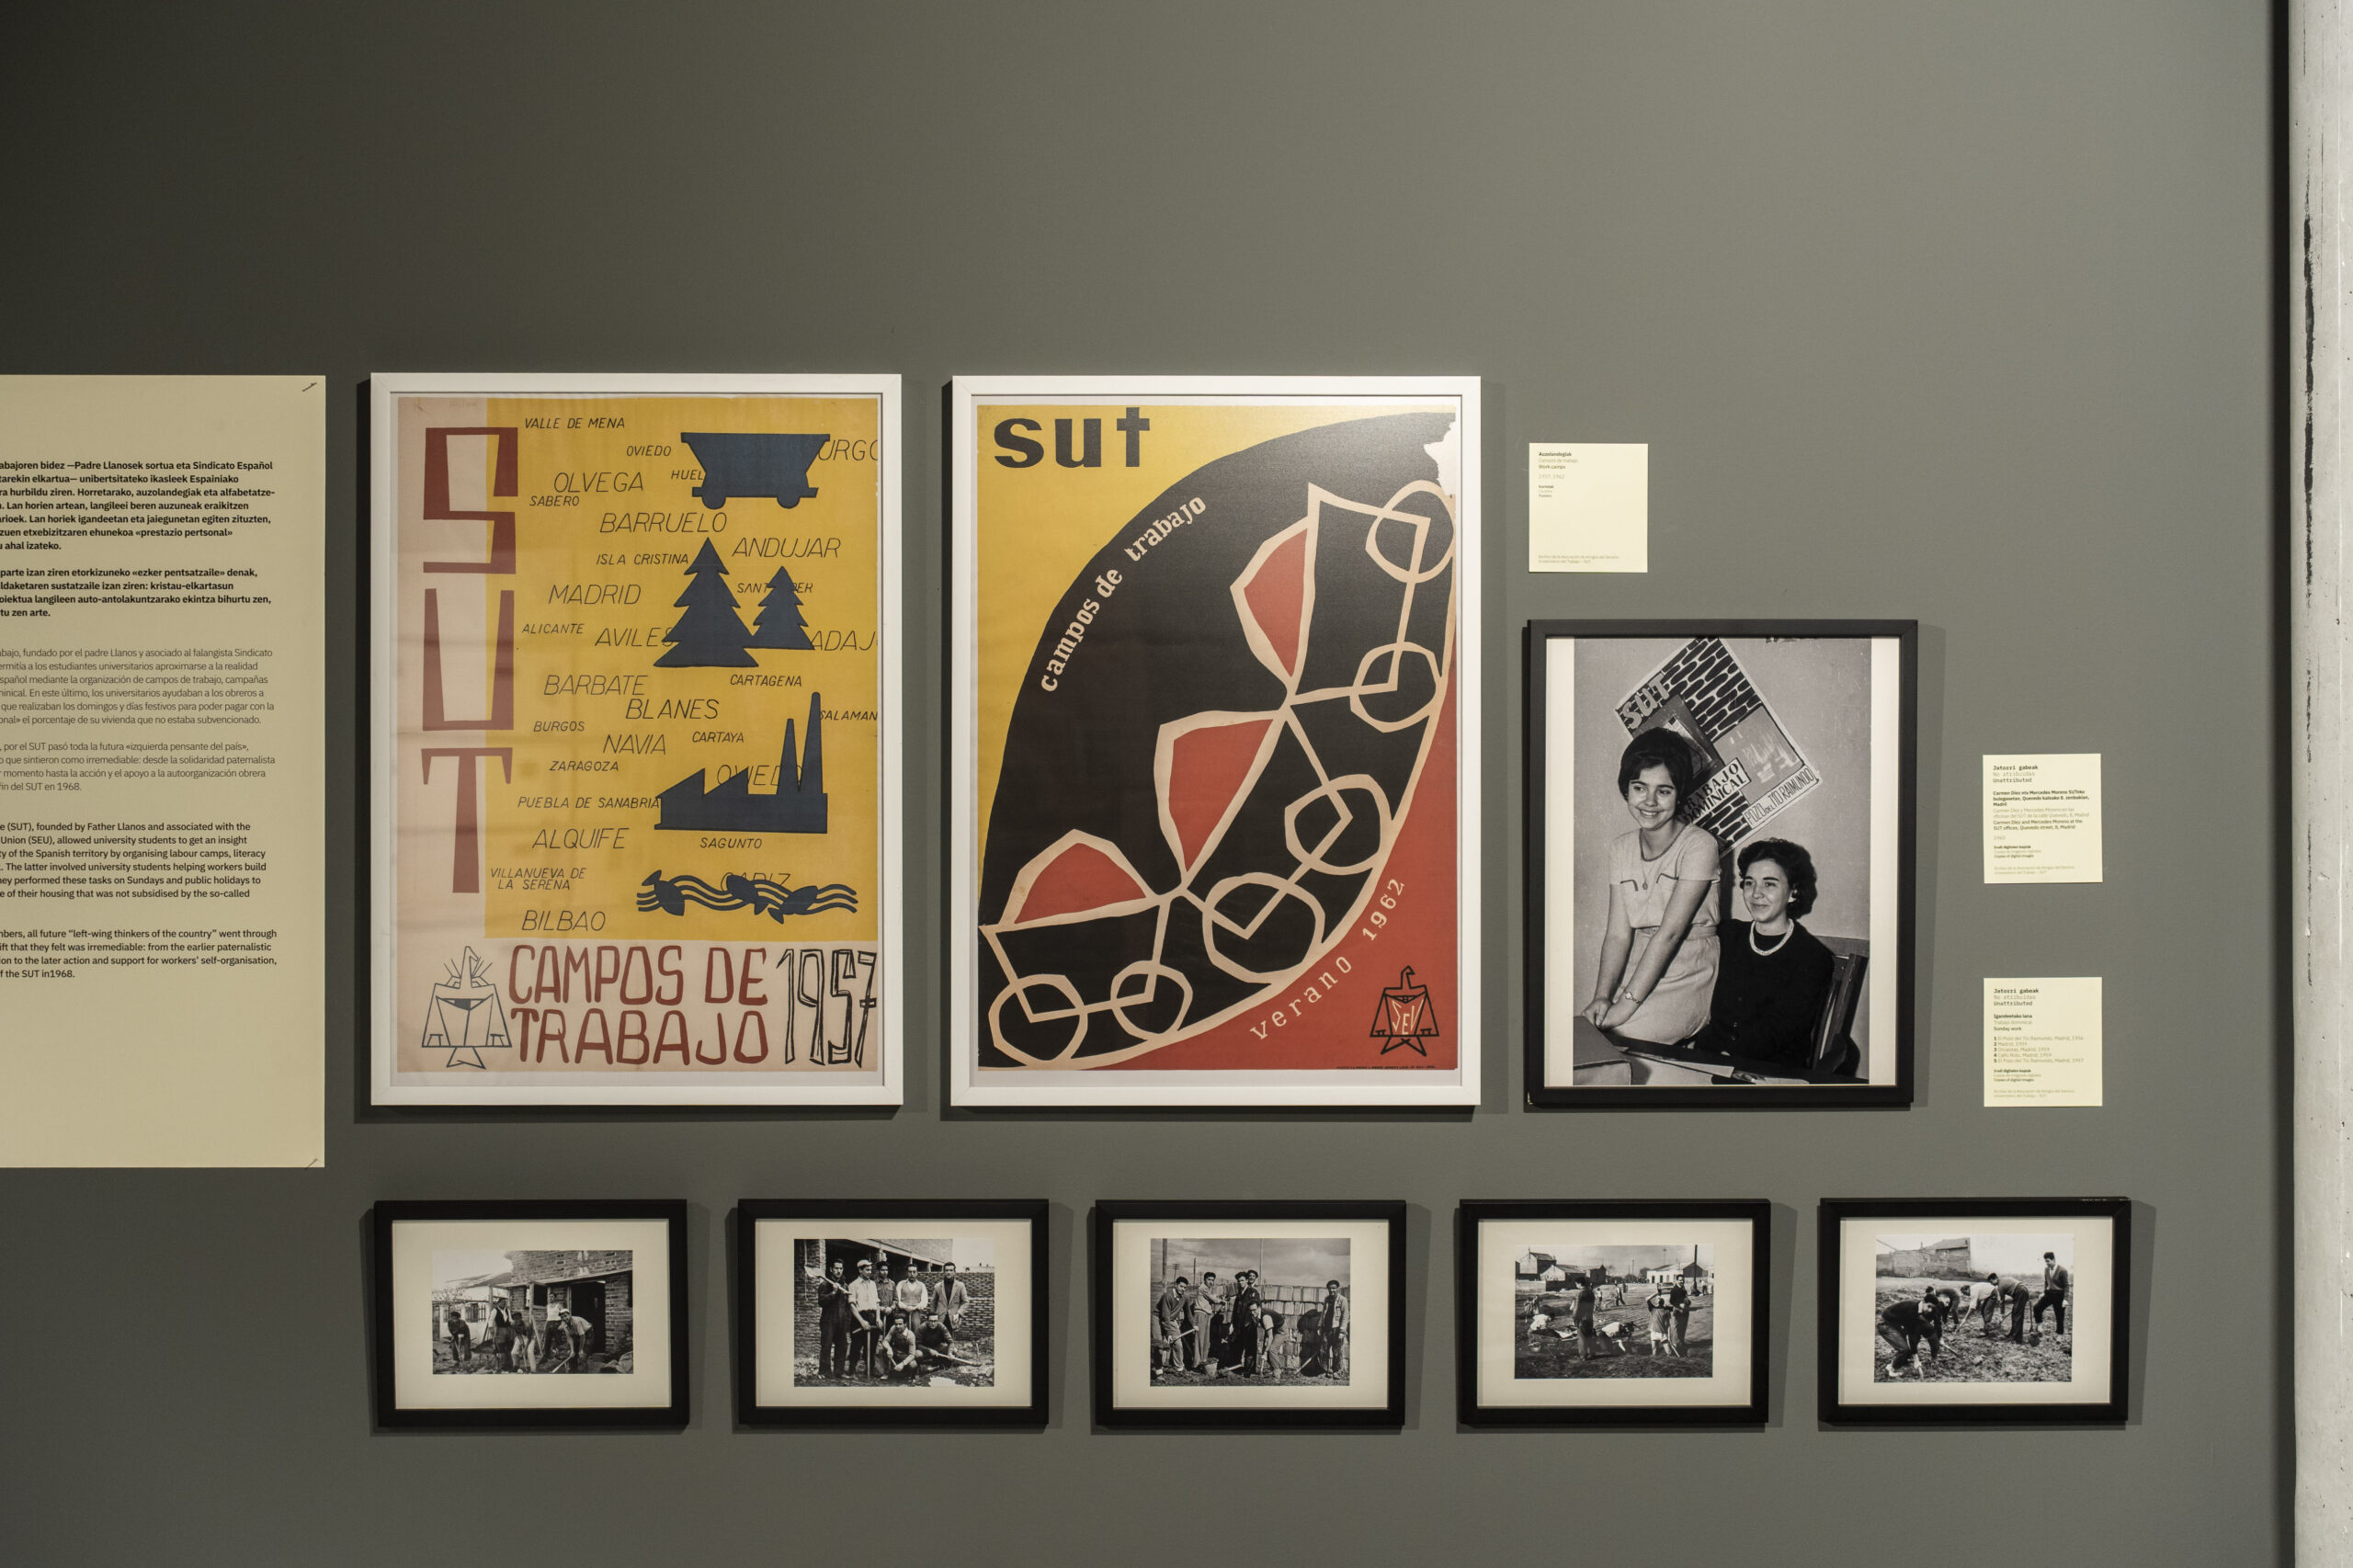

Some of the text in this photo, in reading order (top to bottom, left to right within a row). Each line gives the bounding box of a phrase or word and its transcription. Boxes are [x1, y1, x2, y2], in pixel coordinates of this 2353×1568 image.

[525, 417, 626, 429] VALLE DE MENA
[993, 406, 1151, 469] sut
[626, 445, 672, 457] OVIEDO
[40, 460, 65, 470] bidez
[103, 460, 143, 470] Llanosek
[145, 461, 175, 470] sortua
[193, 461, 235, 470] Sindicato
[237, 461, 273, 472] Español
[79, 474, 149, 483] unibertsitateko
[150, 474, 188, 483] ikasleek
[189, 474, 239, 485] Espainiako
[553, 472, 644, 493] OLVEGA
[9, 487, 48, 496] hurbildu
[50, 487, 75, 496] ziren.
[77, 488, 134, 497] Horretarako,
[136, 488, 202, 498] auzolandegiak
[529, 495, 580, 506] SABERO
[599, 512, 727, 533] BARRUELO
[732, 537, 841, 558] ANDUJAR
[597, 553, 688, 565] ISLA CRISTINA
[0, 569, 25, 578] parte
[26, 568, 45, 576] izan
[47, 568, 70, 576] ziren
[71, 568, 131, 576] etorkizuneko
[164, 568, 225, 578] pentsatzaile»
[226, 568, 257, 577] denak,
[549, 584, 642, 605] MADRID
[1040, 496, 1207, 692] campos de trabajo
[521, 623, 585, 634] ALICANTE
[0, 648, 273, 659] bajo, fundado por el padre Llanos y asociado al falangista Sindicato
[28, 676, 69, 684] mediante
[70, 675, 78, 684] la
[79, 675, 131, 686] organización
[132, 675, 144, 684] de
[144, 676, 179, 686] campos
[179, 675, 191, 684] de
[192, 676, 223, 686] trabajo,
[224, 675, 268, 686] campañas
[544, 675, 649, 696] BARBATE
[730, 674, 802, 687] CARTAGENA
[1622, 673, 1669, 729] SUT
[625, 699, 720, 720] BLANES
[533, 721, 585, 733] BURGOS
[692, 731, 745, 744] CARTAYA
[602, 734, 666, 755] NAVIA
[549, 760, 620, 772] ZARAGOZA
[517, 796, 659, 809] PUEBLA DE SANABRIA
[1745, 802, 1767, 825] POZO
[1779, 767, 1814, 801] RAIMUNDO
[7, 822, 251, 833] (SUT), founded by Father Llanos and associated with the
[531, 827, 630, 849] ALQUIFE
[699, 837, 763, 849] SAGUNTO
[490, 867, 587, 880] VILLANUEVA DE
[497, 879, 571, 891] LA SERENA
[521, 909, 607, 932] BILBAO
[27, 929, 38, 937] all
[40, 929, 67, 938] future
[114, 929, 150, 937] thinkers
[151, 929, 161, 937] of
[162, 929, 176, 937] the
[243, 929, 277, 940] through
[1250, 878, 1405, 1040] verano 1962
[508, 944, 768, 1006] CAMPOS DE
[776, 948, 878, 1068] 1957
[510, 1007, 769, 1066] TRABAJO
